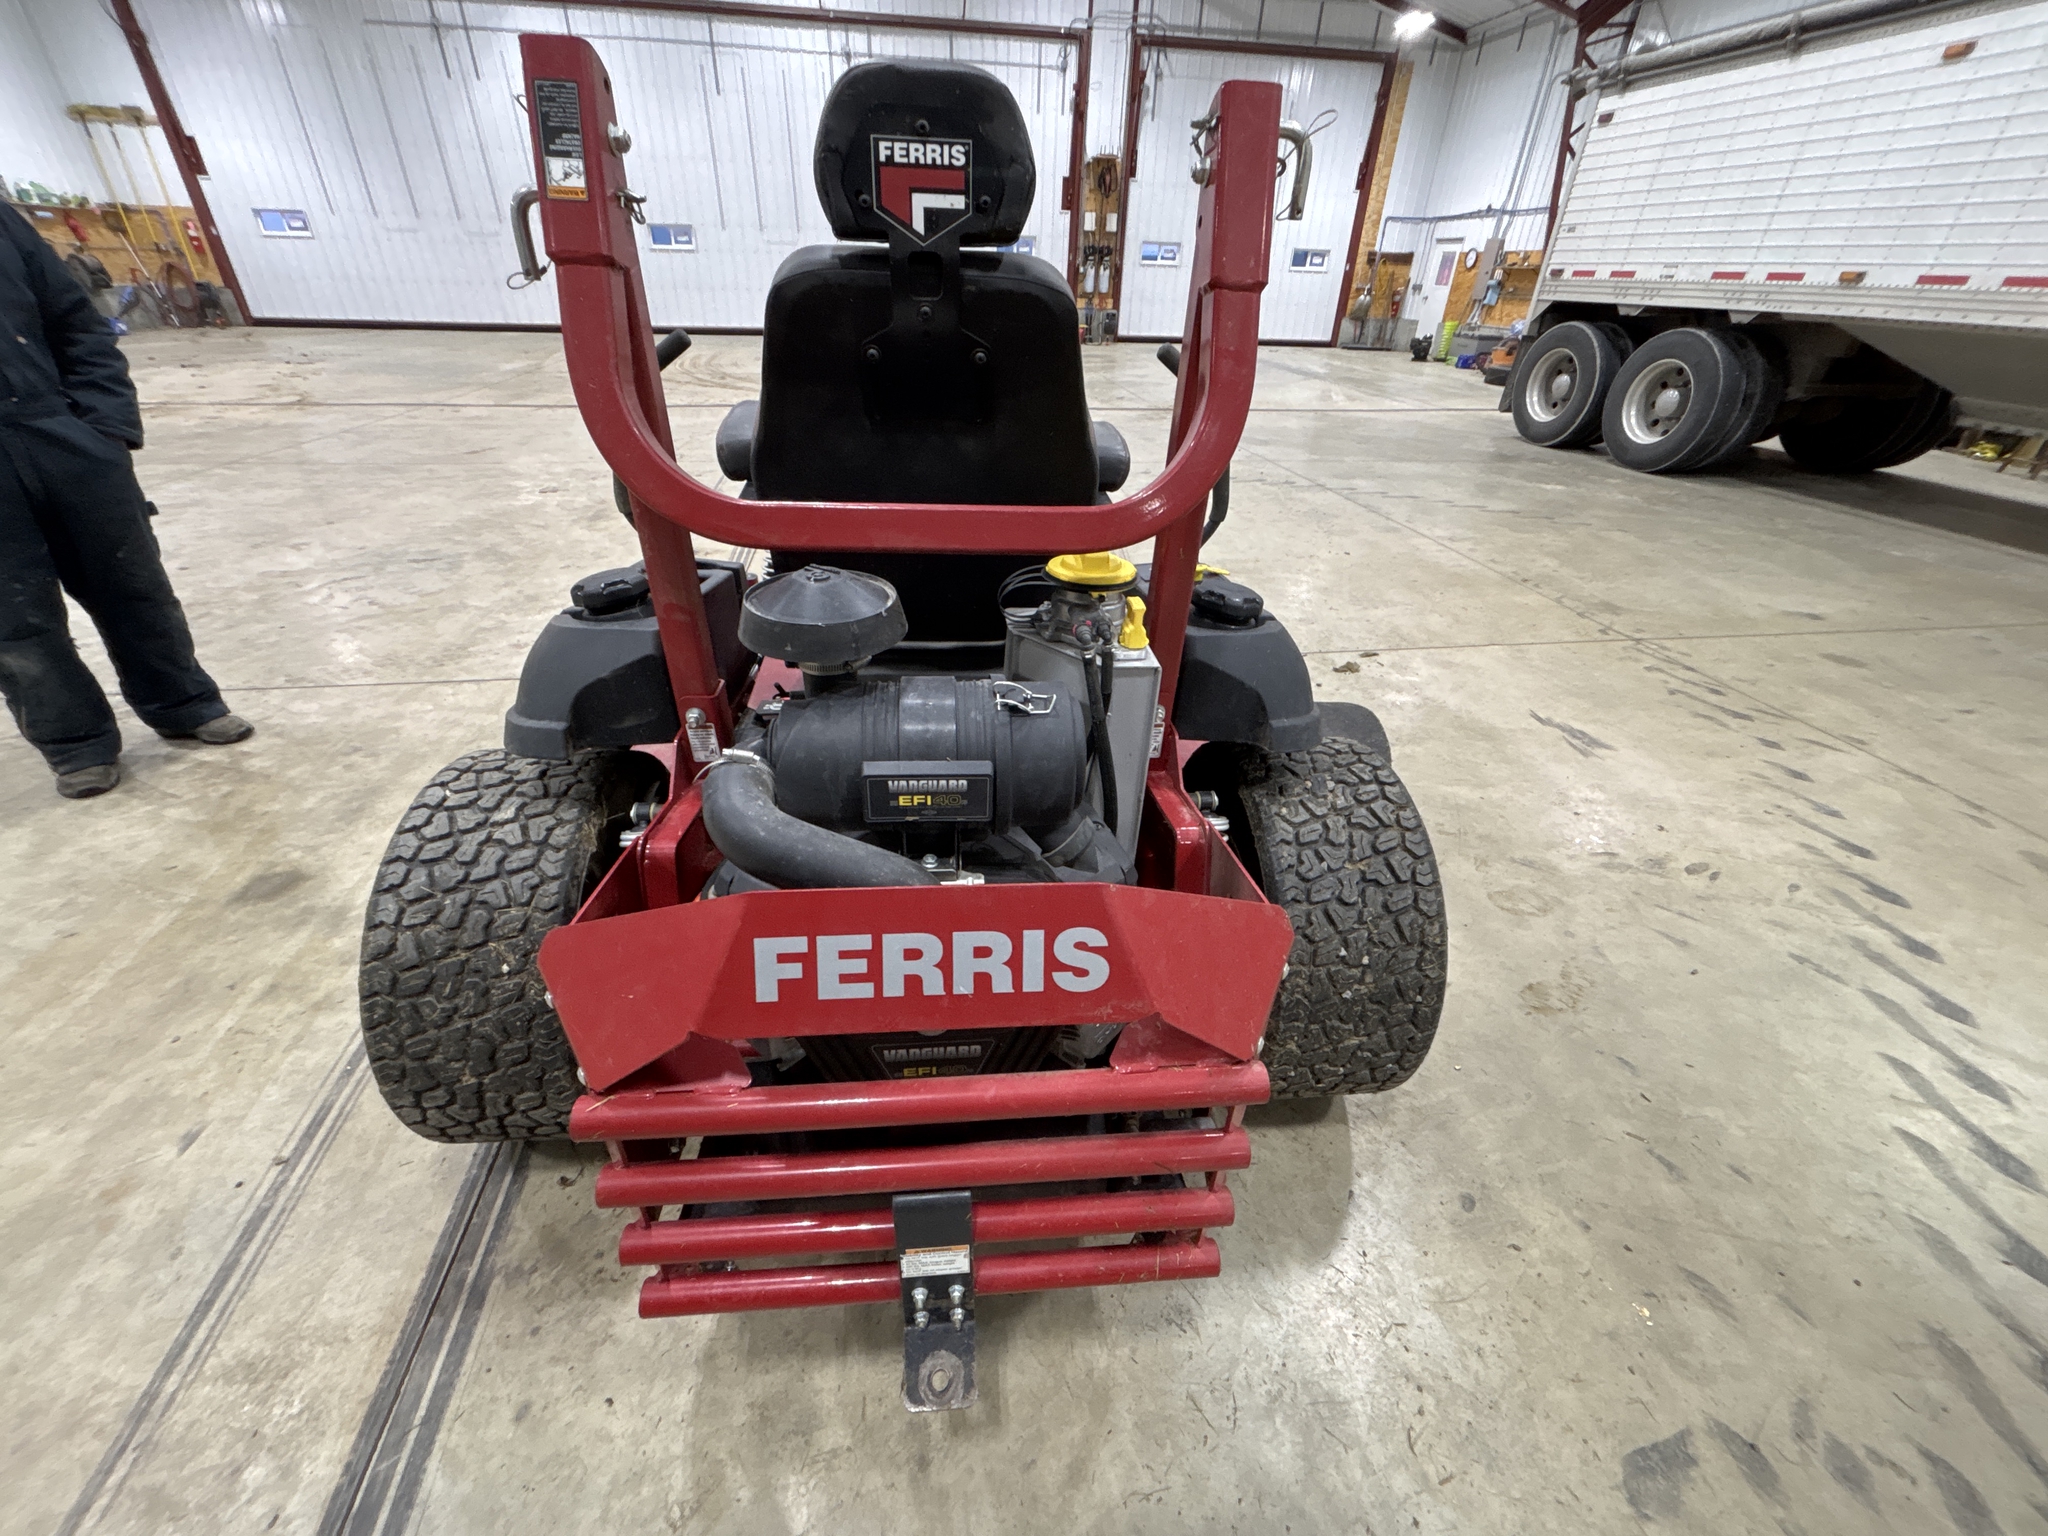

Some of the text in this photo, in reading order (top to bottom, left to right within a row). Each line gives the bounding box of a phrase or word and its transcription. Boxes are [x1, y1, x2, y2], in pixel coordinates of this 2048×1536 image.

[879, 141, 966, 167] FERRIS
[887, 780, 968, 794] VANGUARD
[753, 927, 1110, 1003] FERRIS
[883, 1045, 982, 1063] VANGUARD
